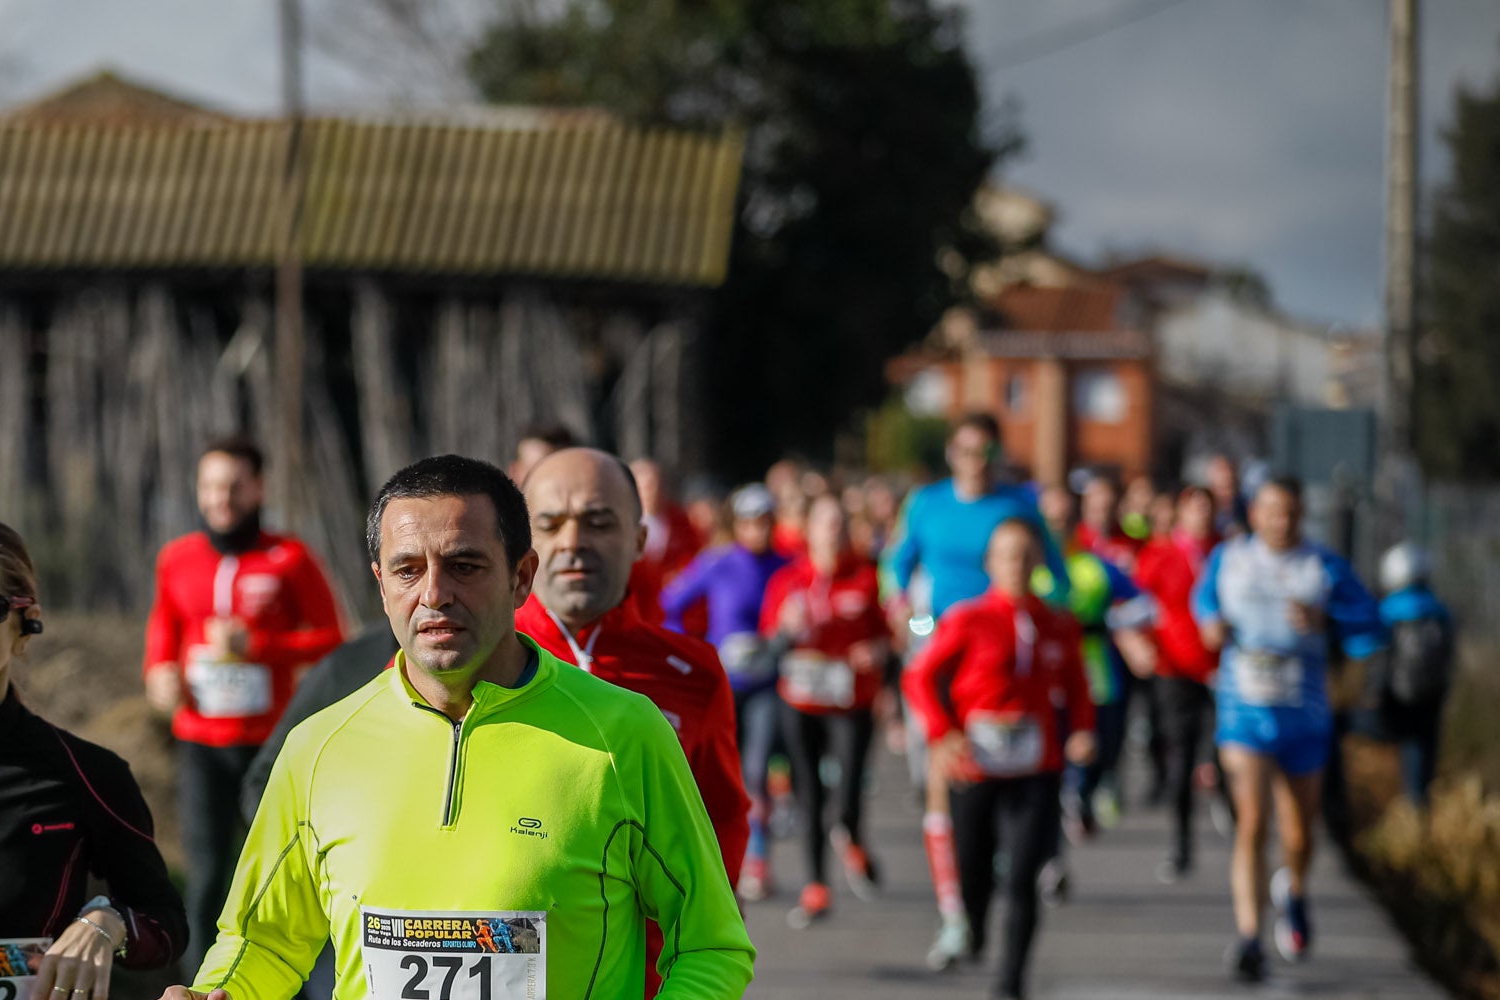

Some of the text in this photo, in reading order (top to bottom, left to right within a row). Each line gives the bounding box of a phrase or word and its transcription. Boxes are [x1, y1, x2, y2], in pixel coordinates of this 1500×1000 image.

[510, 826, 548, 840] Kalenji
[367, 915, 381, 930] 26
[391, 918, 405, 938] VII
[404, 919, 472, 931] CARRERA
[367, 934, 381, 944] Ruta
[382, 937, 390, 945] de
[391, 938, 402, 947] los
[403, 939, 441, 949] Secaderos
[405, 929, 472, 940] POPULAR
